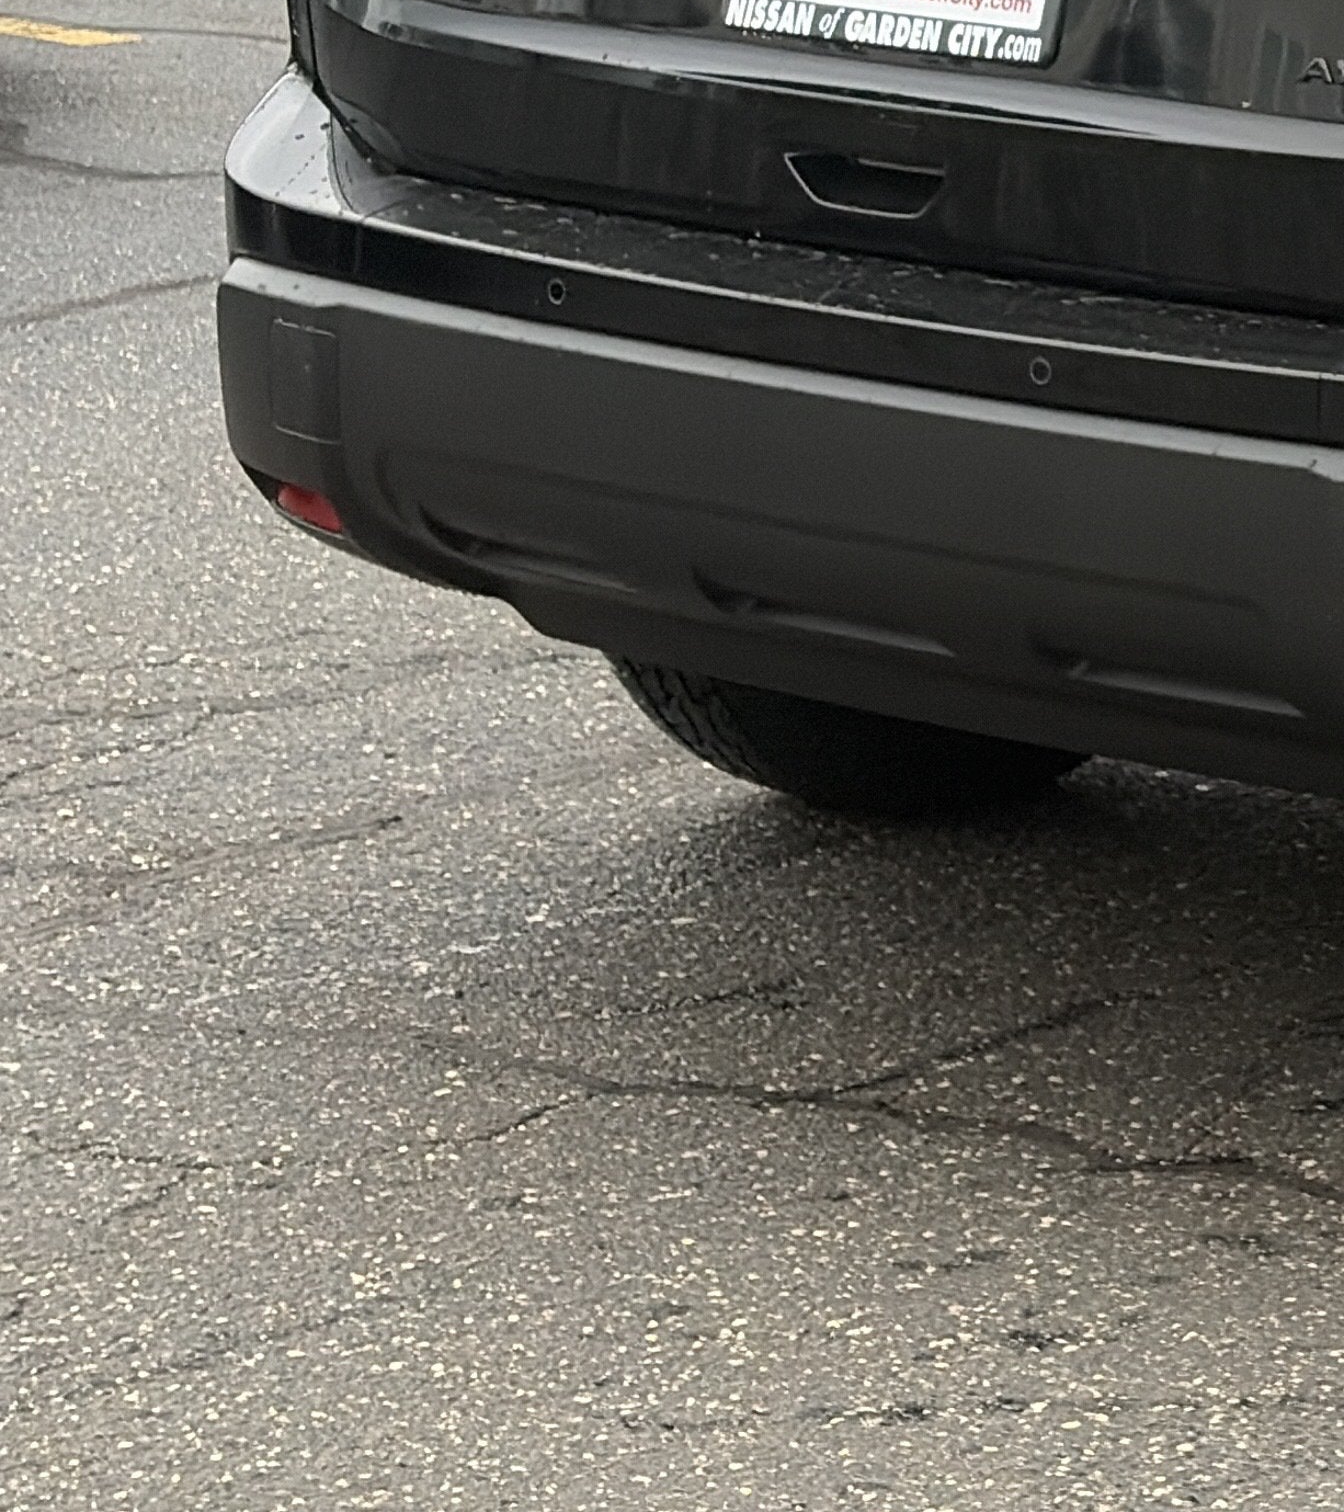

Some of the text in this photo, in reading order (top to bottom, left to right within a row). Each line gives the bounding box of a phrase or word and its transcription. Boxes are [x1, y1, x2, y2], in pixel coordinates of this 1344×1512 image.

[818, 8, 846, 38] of
[844, 10, 943, 53] GARDEN
[947, 22, 1043, 64] CITY.com
